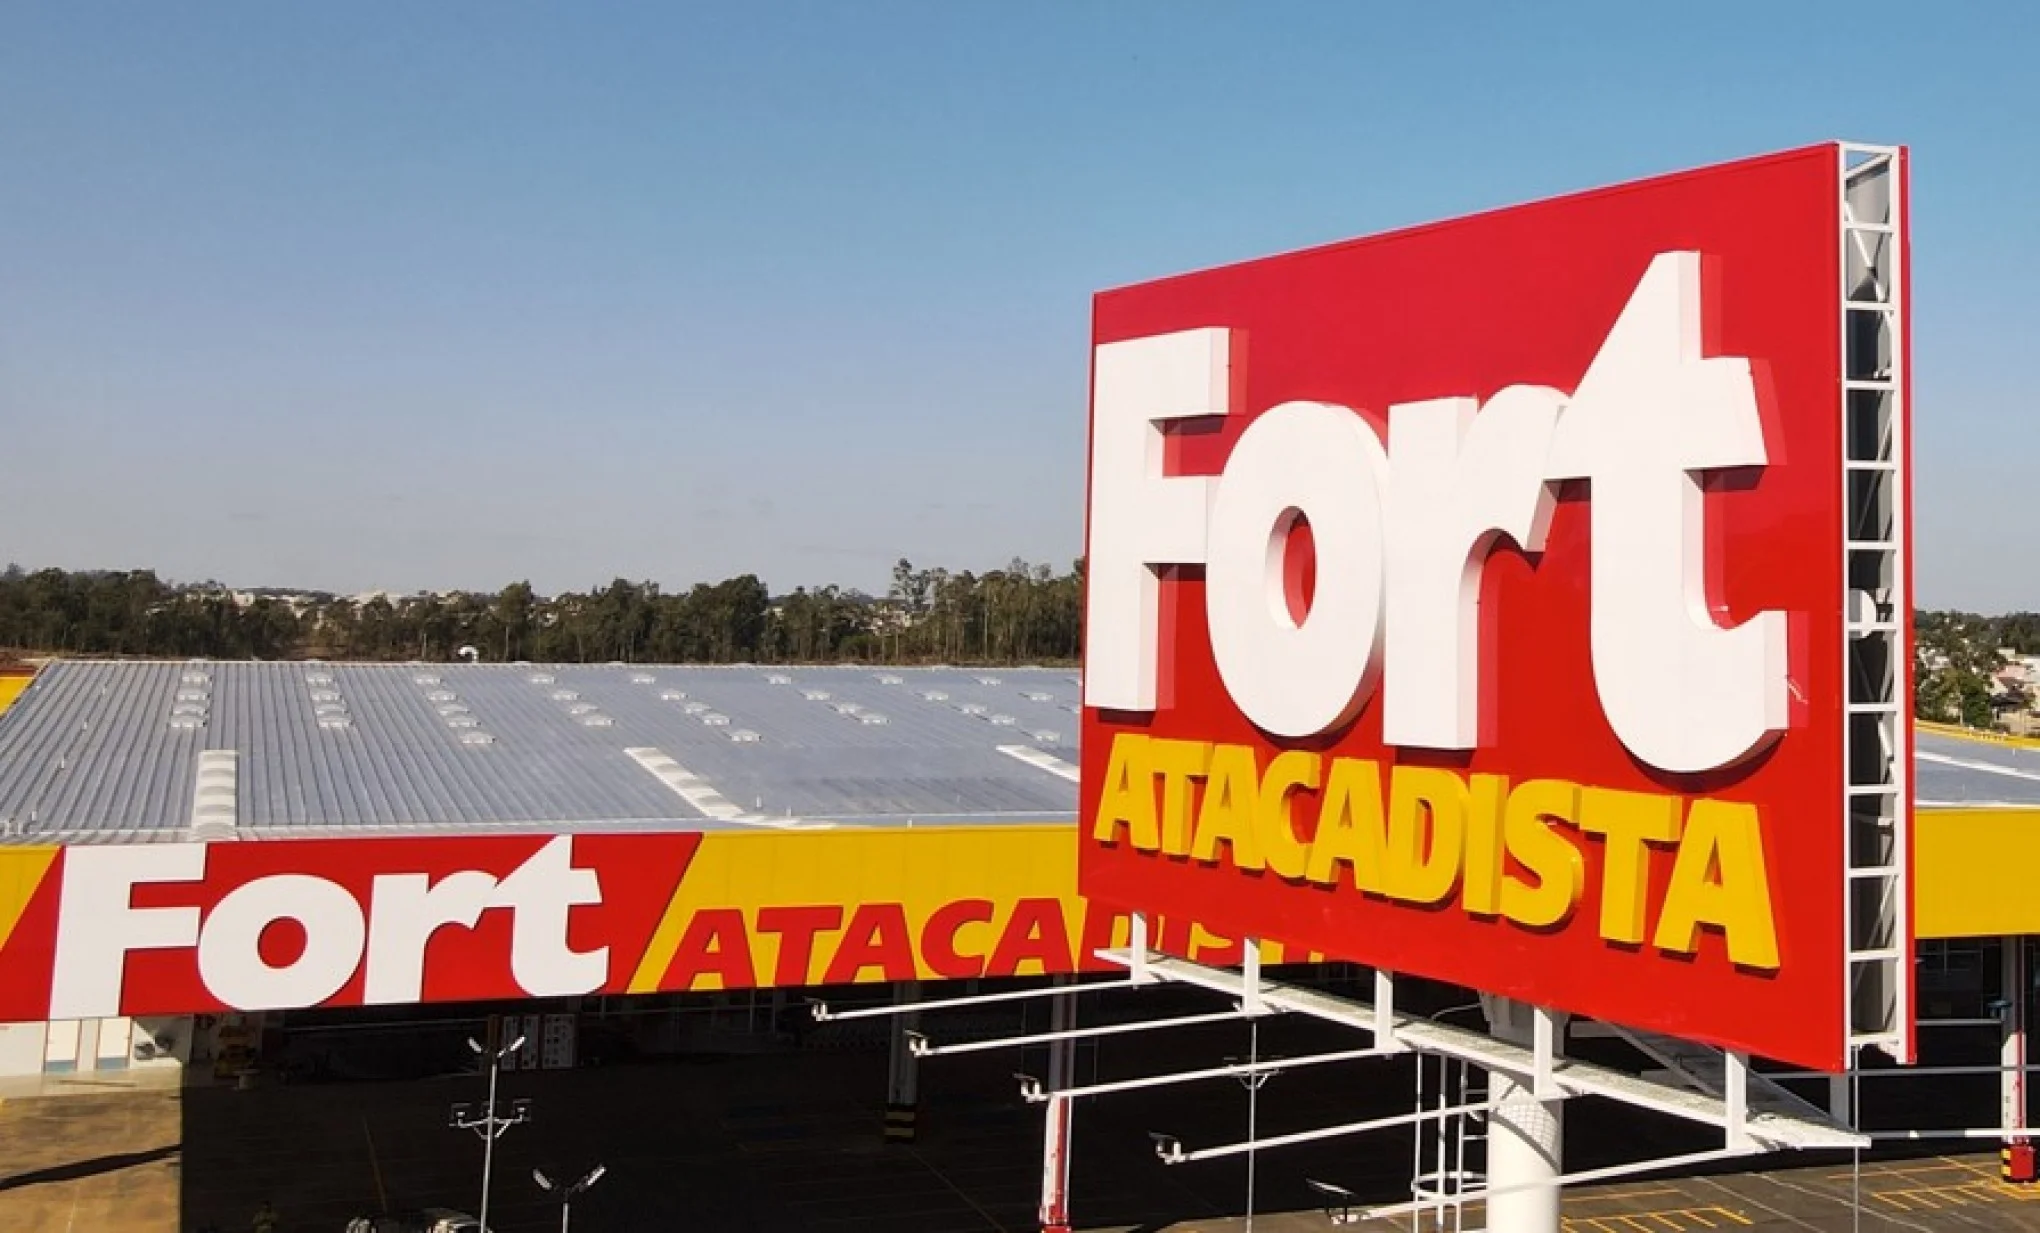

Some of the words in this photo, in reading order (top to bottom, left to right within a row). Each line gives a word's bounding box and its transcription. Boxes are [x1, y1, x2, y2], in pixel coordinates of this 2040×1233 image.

[1085, 250, 1788, 772] Fort
[49, 833, 609, 1020] Fort
[1093, 733, 1779, 968] ATACADISTA
